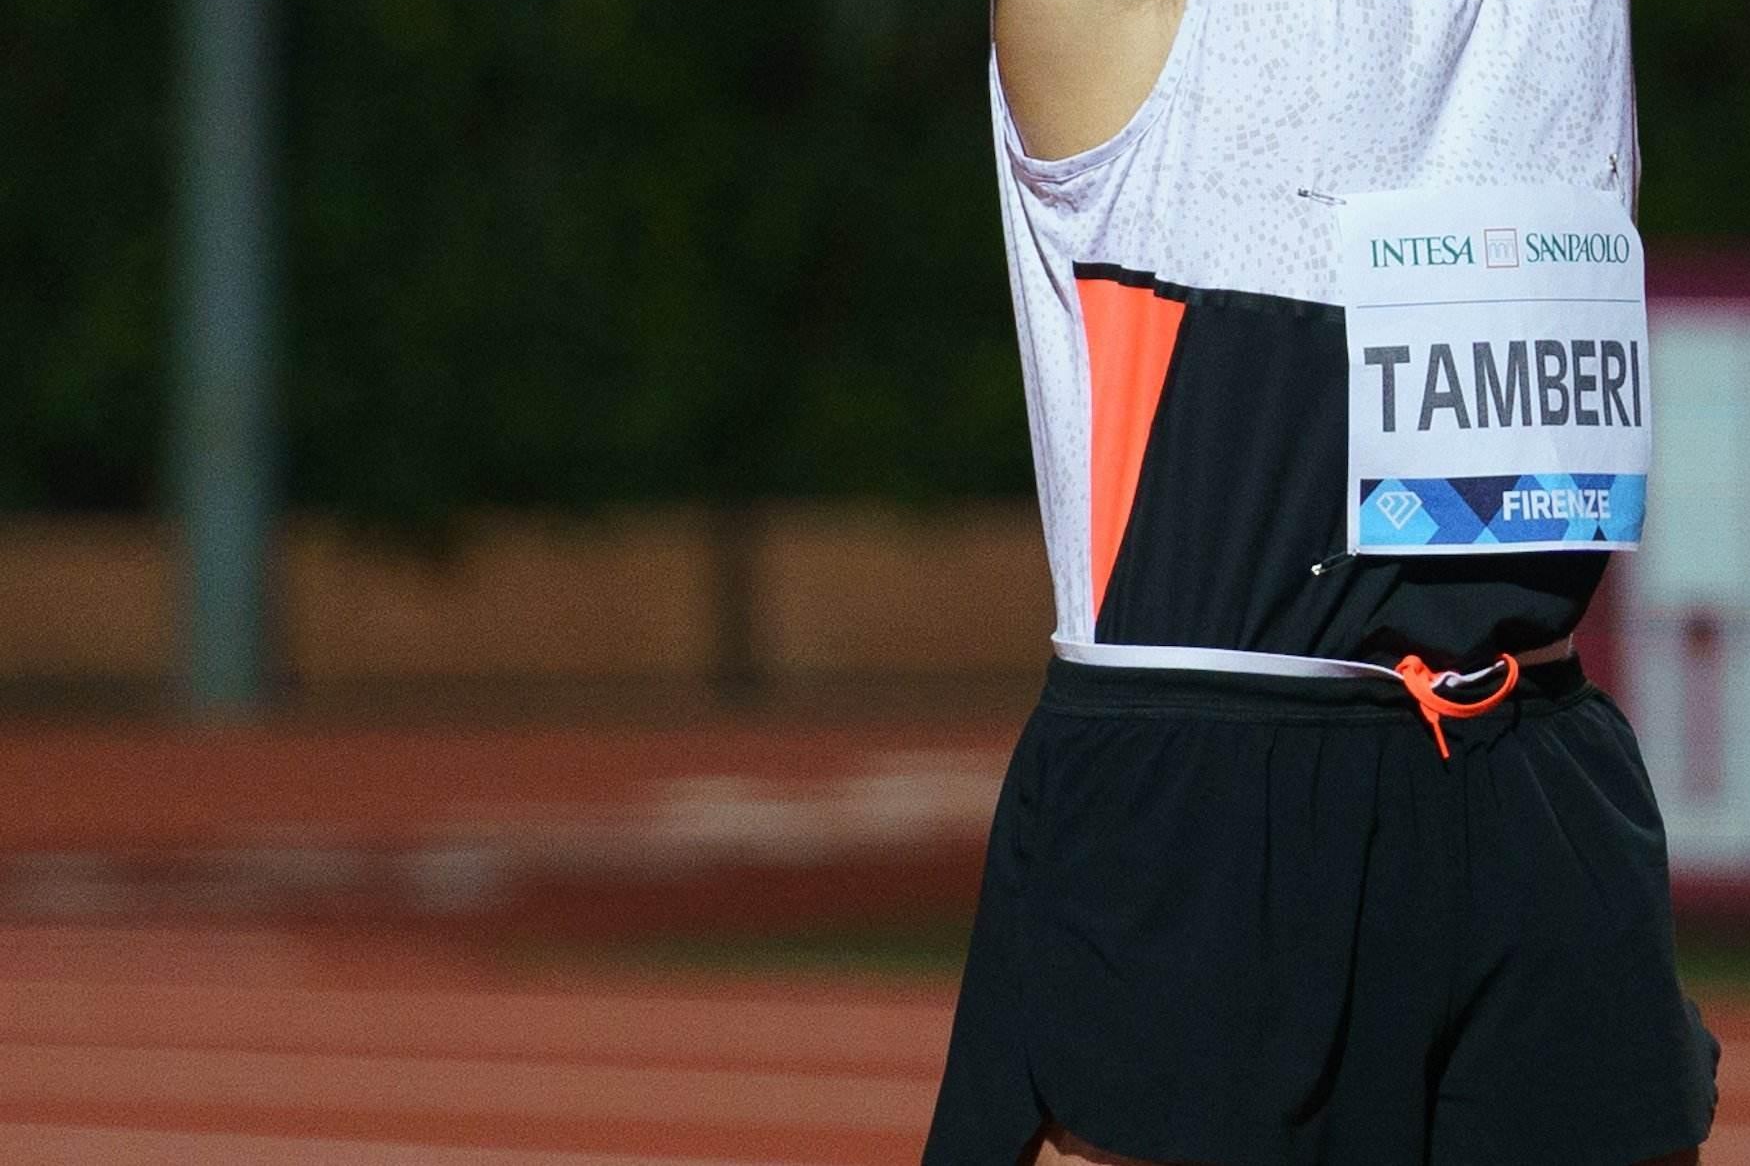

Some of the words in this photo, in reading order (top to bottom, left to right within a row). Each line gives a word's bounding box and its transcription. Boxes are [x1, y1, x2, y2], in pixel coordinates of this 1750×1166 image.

[1370, 235, 1475, 267] INTESA
[1526, 233, 1629, 263] SANPAOLO
[1363, 340, 1642, 432] TAMBERI
[1502, 490, 1610, 521] FIRENZE
